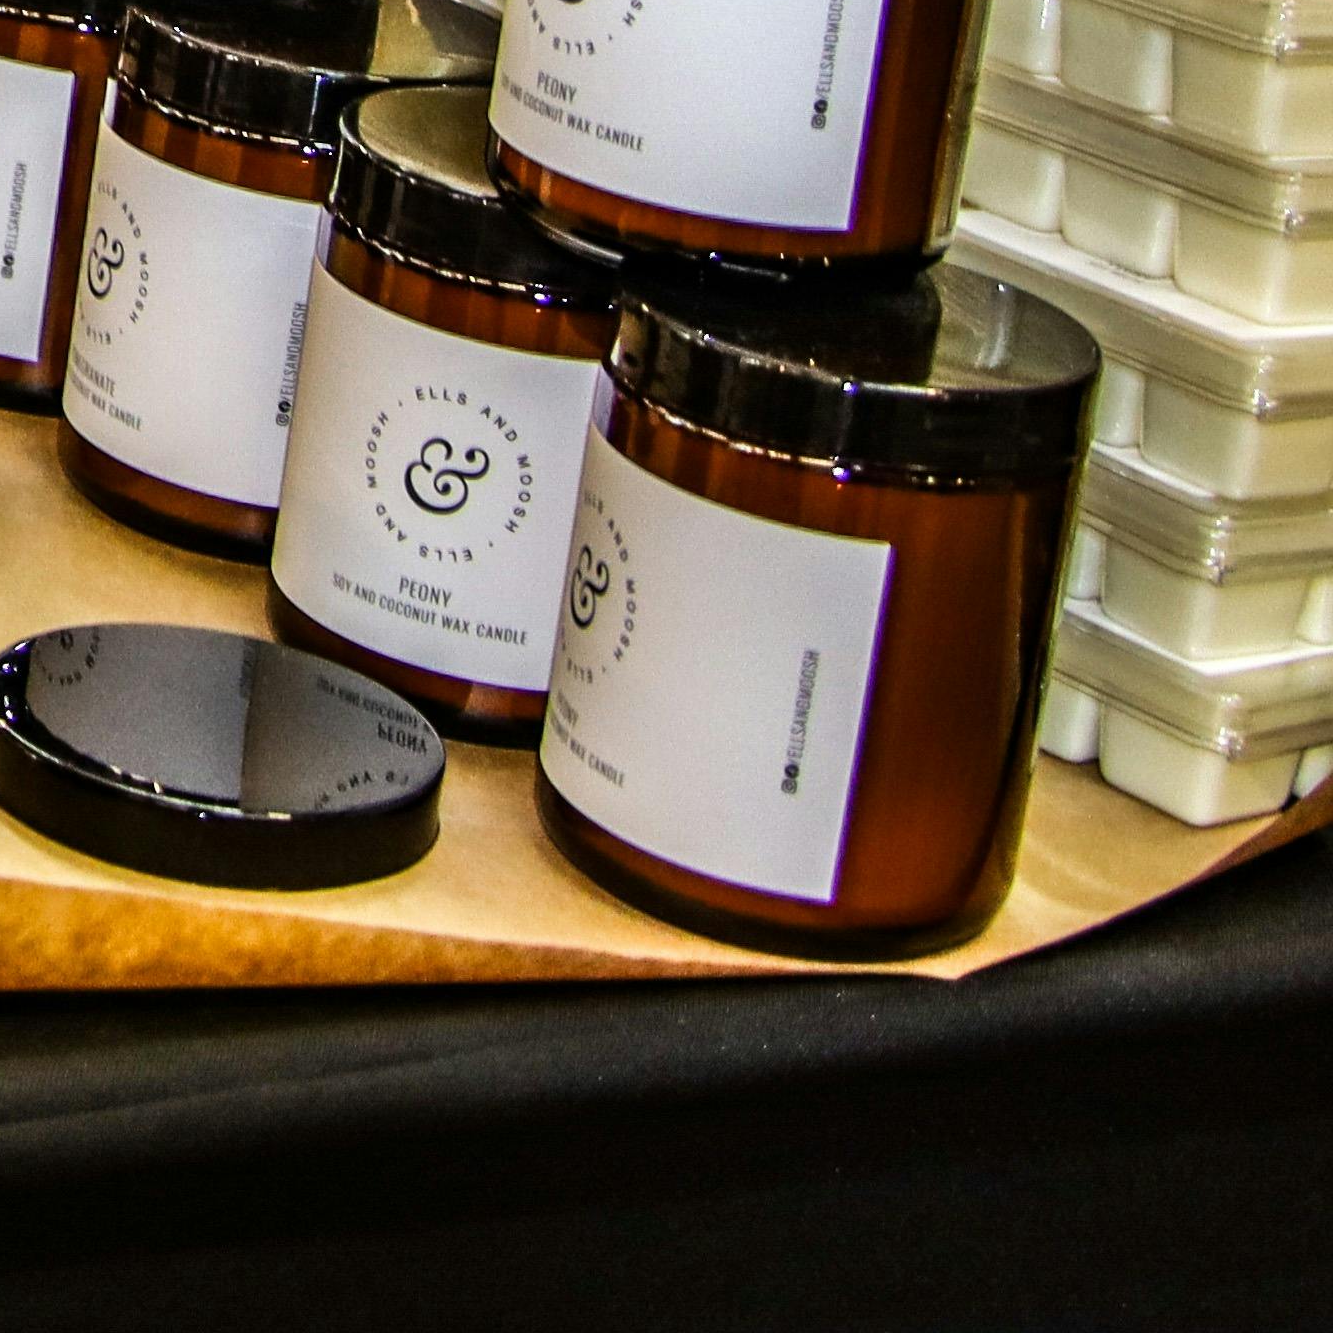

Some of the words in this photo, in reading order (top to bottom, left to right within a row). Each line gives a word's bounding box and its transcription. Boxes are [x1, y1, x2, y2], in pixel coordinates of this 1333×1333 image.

[537, 70, 577, 104] PEONY
[523, 91, 565, 122] COCONUT
[567, 110, 591, 135] WAX
[595, 123, 645, 152] CANDLE
[121, 202, 142, 239] AND
[88, 227, 125, 300] &
[129, 251, 150, 325] MOOSH
[109, 406, 142, 433] CANDLE
[365, 411, 389, 489] MOOSH
[404, 437, 490, 515] &
[415, 386, 467, 406] ELLS
[480, 405, 518, 443] AND
[504, 453, 533, 534] MOOSH
[375, 504, 407, 542] AND
[419, 544, 473, 563] ELLS
[607, 518, 629, 563] AND
[333, 573, 352, 594] SOY
[354, 583, 376, 606] AND
[379, 595, 437, 627] COCONUT
[441, 615, 470, 636] WAX
[476, 624, 528, 646] CANDLE
[398, 577, 452, 608] PEONY
[571, 544, 610, 630] &
[613, 579, 637, 662] MOOSH
[570, 737, 585, 762] WAX
[588, 753, 625, 789] CANDLE
